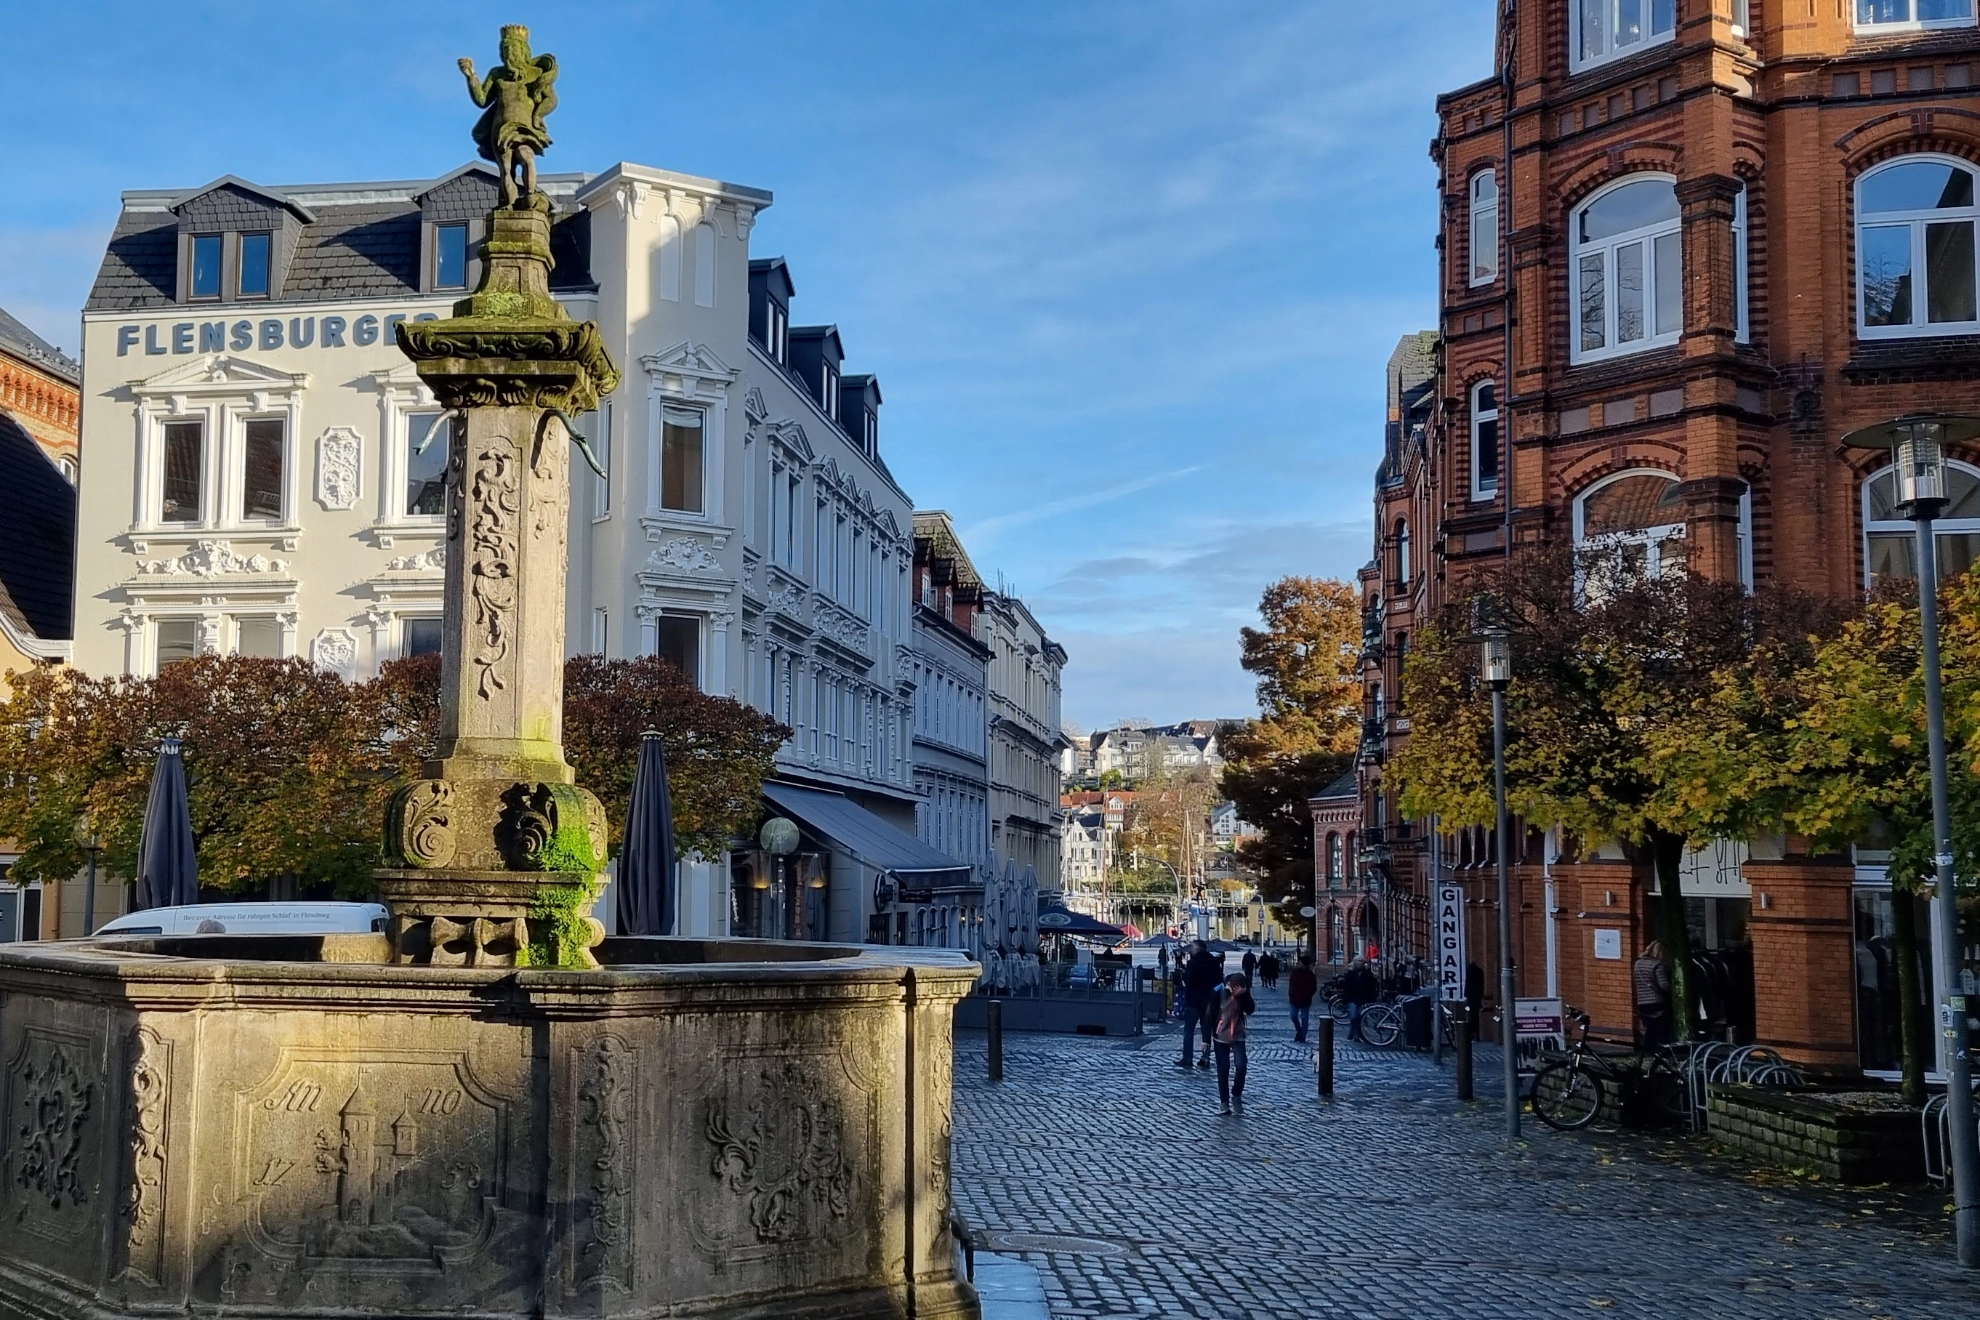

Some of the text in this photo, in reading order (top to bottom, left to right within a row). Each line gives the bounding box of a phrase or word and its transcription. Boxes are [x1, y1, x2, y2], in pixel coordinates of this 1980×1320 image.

[237, 912, 247, 920] für
[247, 912, 271, 921] ruhigen
[301, 911, 331, 920] Flensburg
[1441, 888, 1459, 999] GANGART
